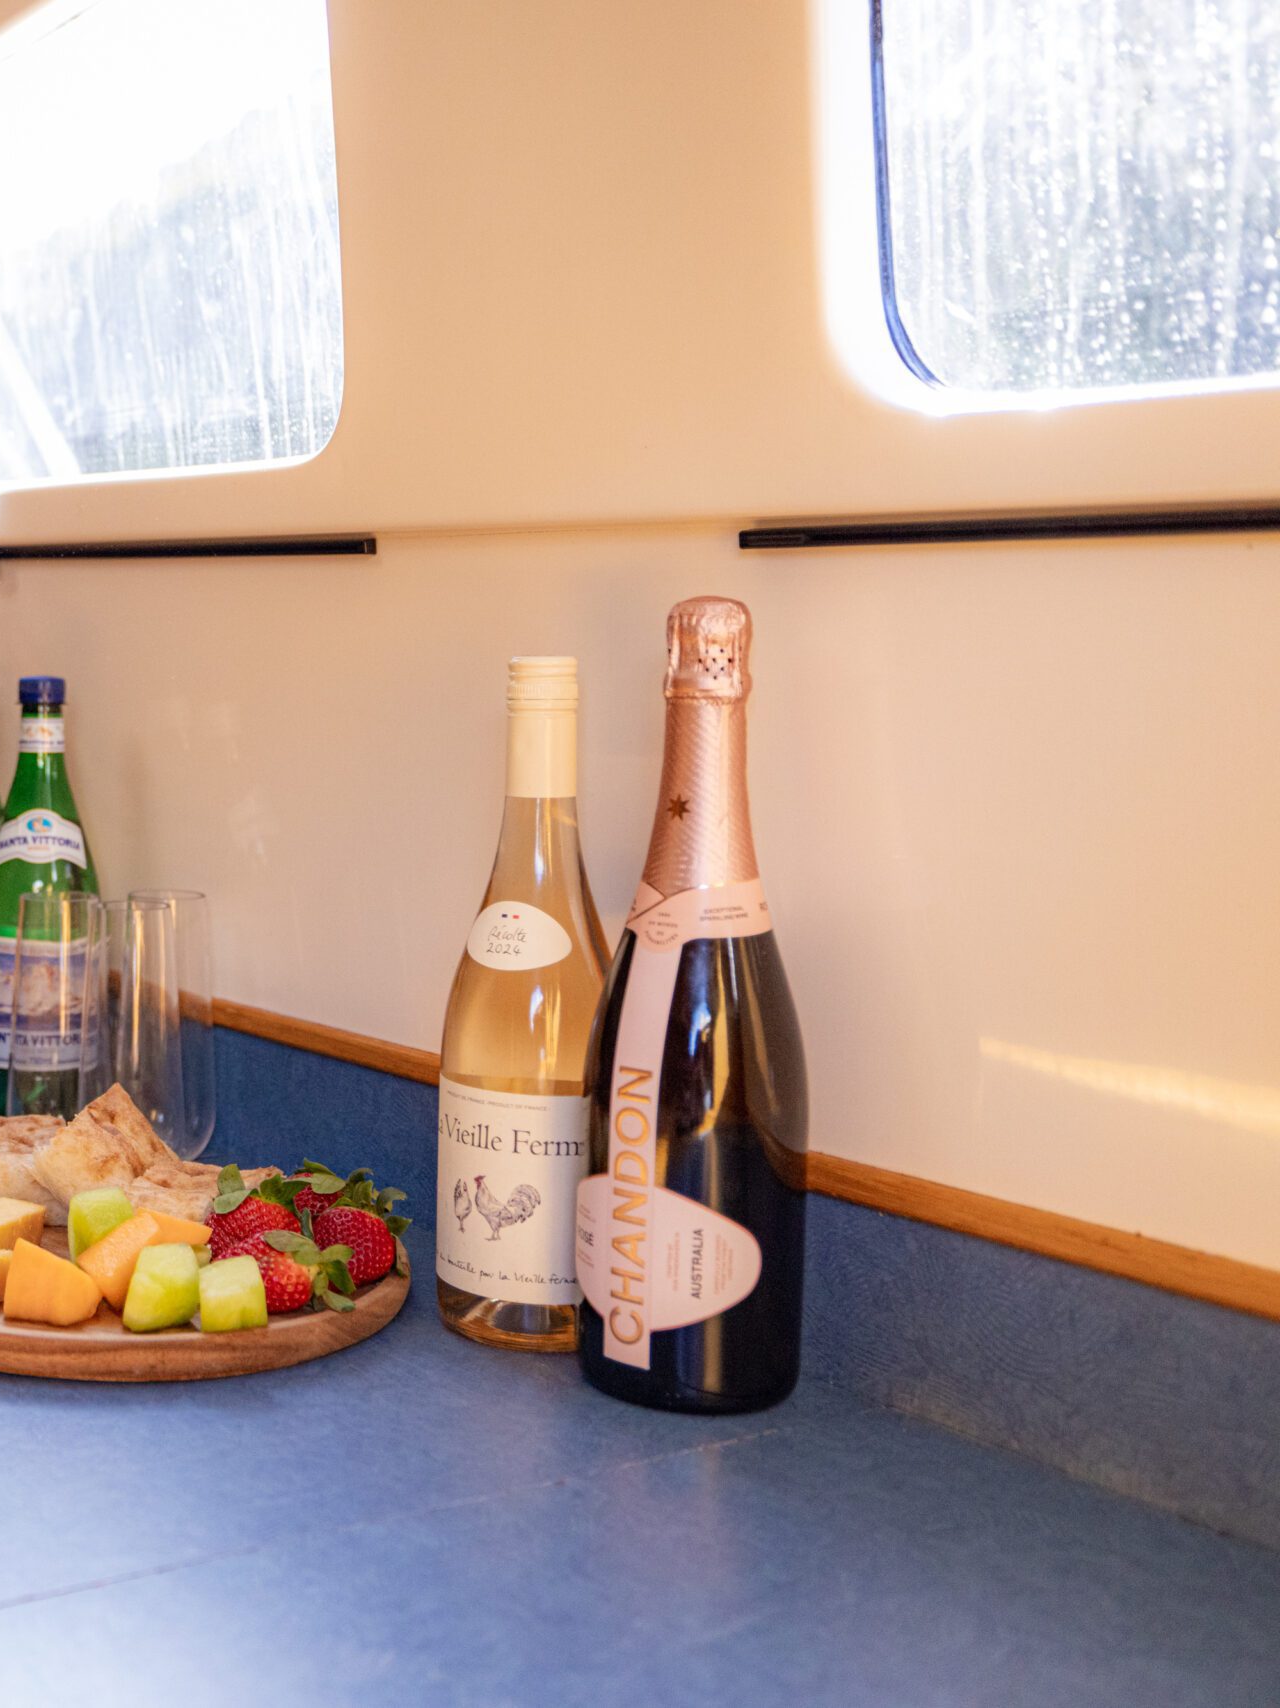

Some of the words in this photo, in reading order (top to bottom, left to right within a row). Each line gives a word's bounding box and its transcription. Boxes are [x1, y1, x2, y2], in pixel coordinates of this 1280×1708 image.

[486, 942, 522, 956] 2024
[444, 1113, 502, 1152] Vieille
[608, 1065, 653, 1345] CHANDON
[690, 1227, 705, 1301] AUSTRALIA
